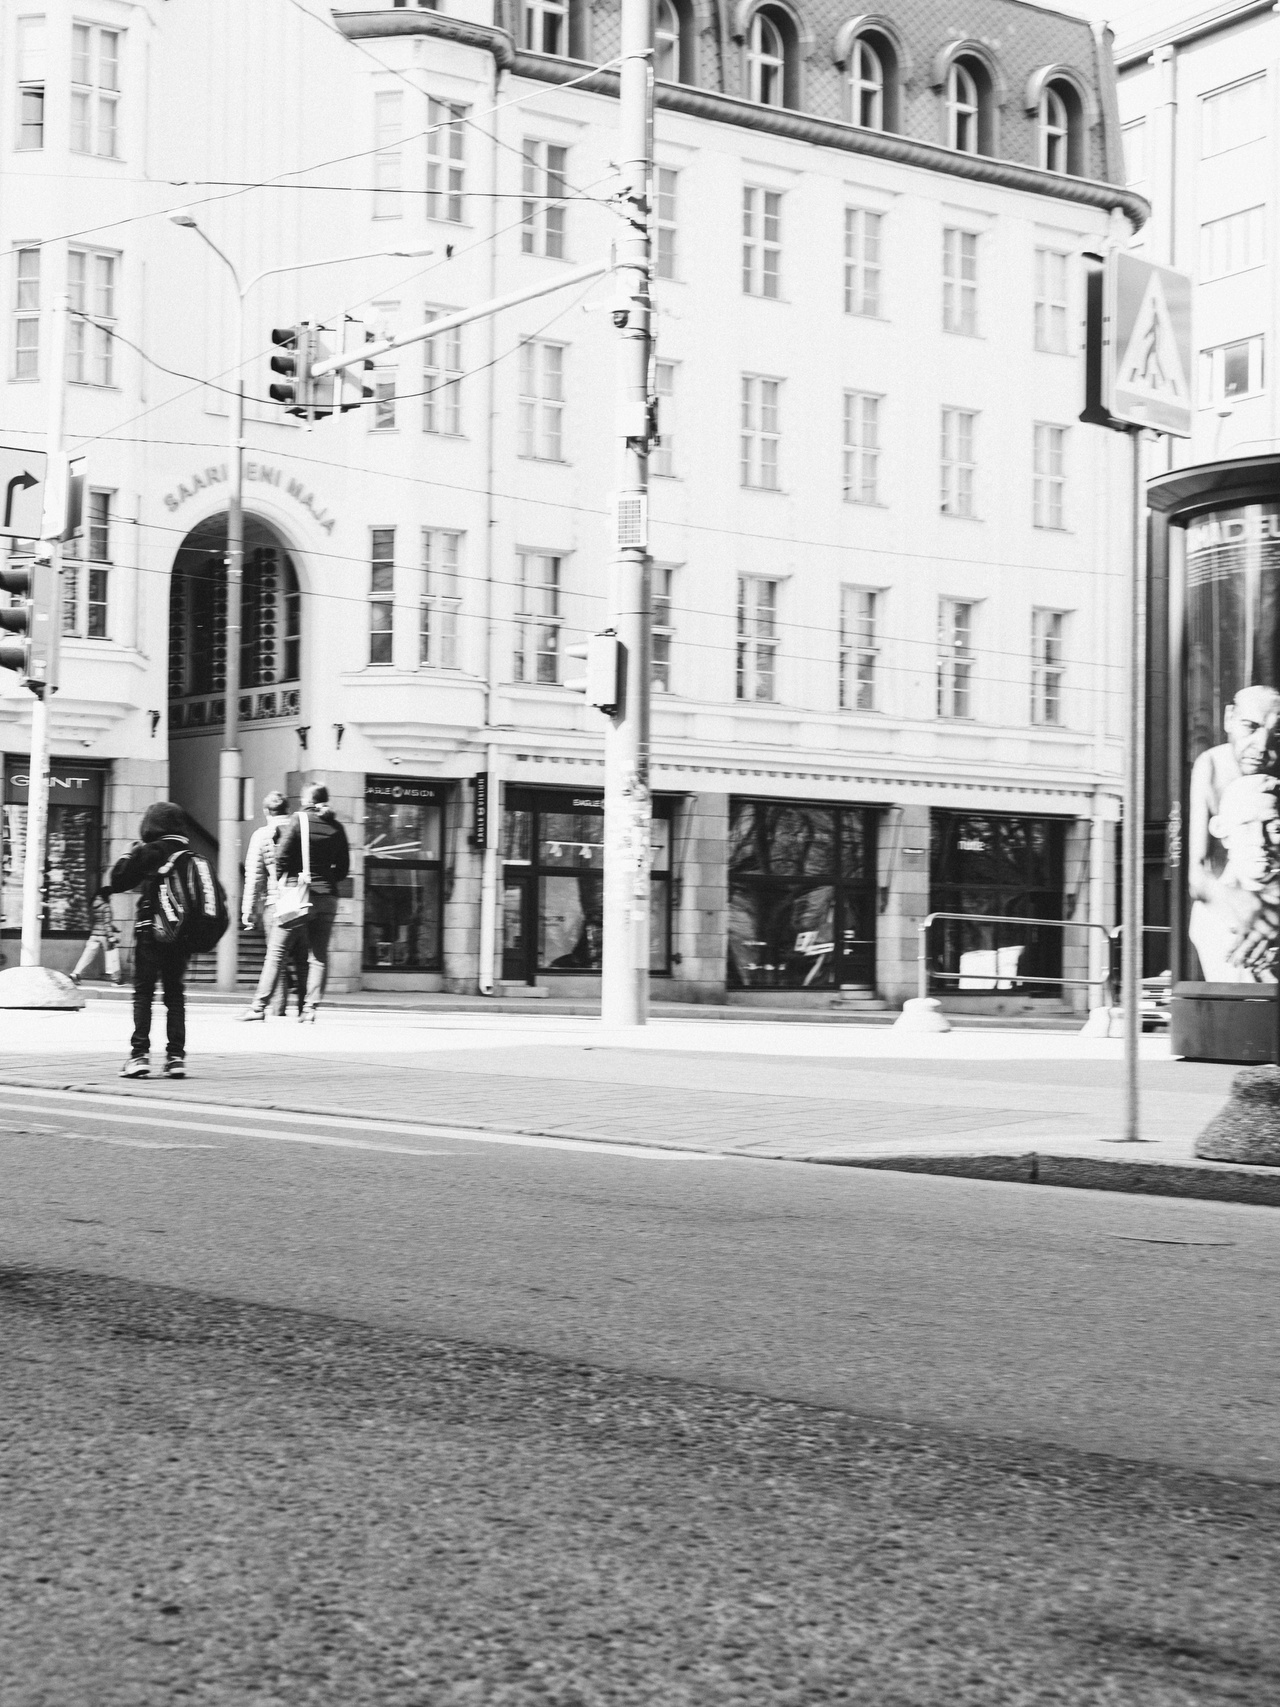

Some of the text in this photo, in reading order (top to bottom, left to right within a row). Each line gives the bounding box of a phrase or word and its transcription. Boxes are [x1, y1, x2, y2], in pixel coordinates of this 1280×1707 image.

[163, 461, 336, 536] SAARIENI MAJA
[10, 774, 90, 789] GNT
